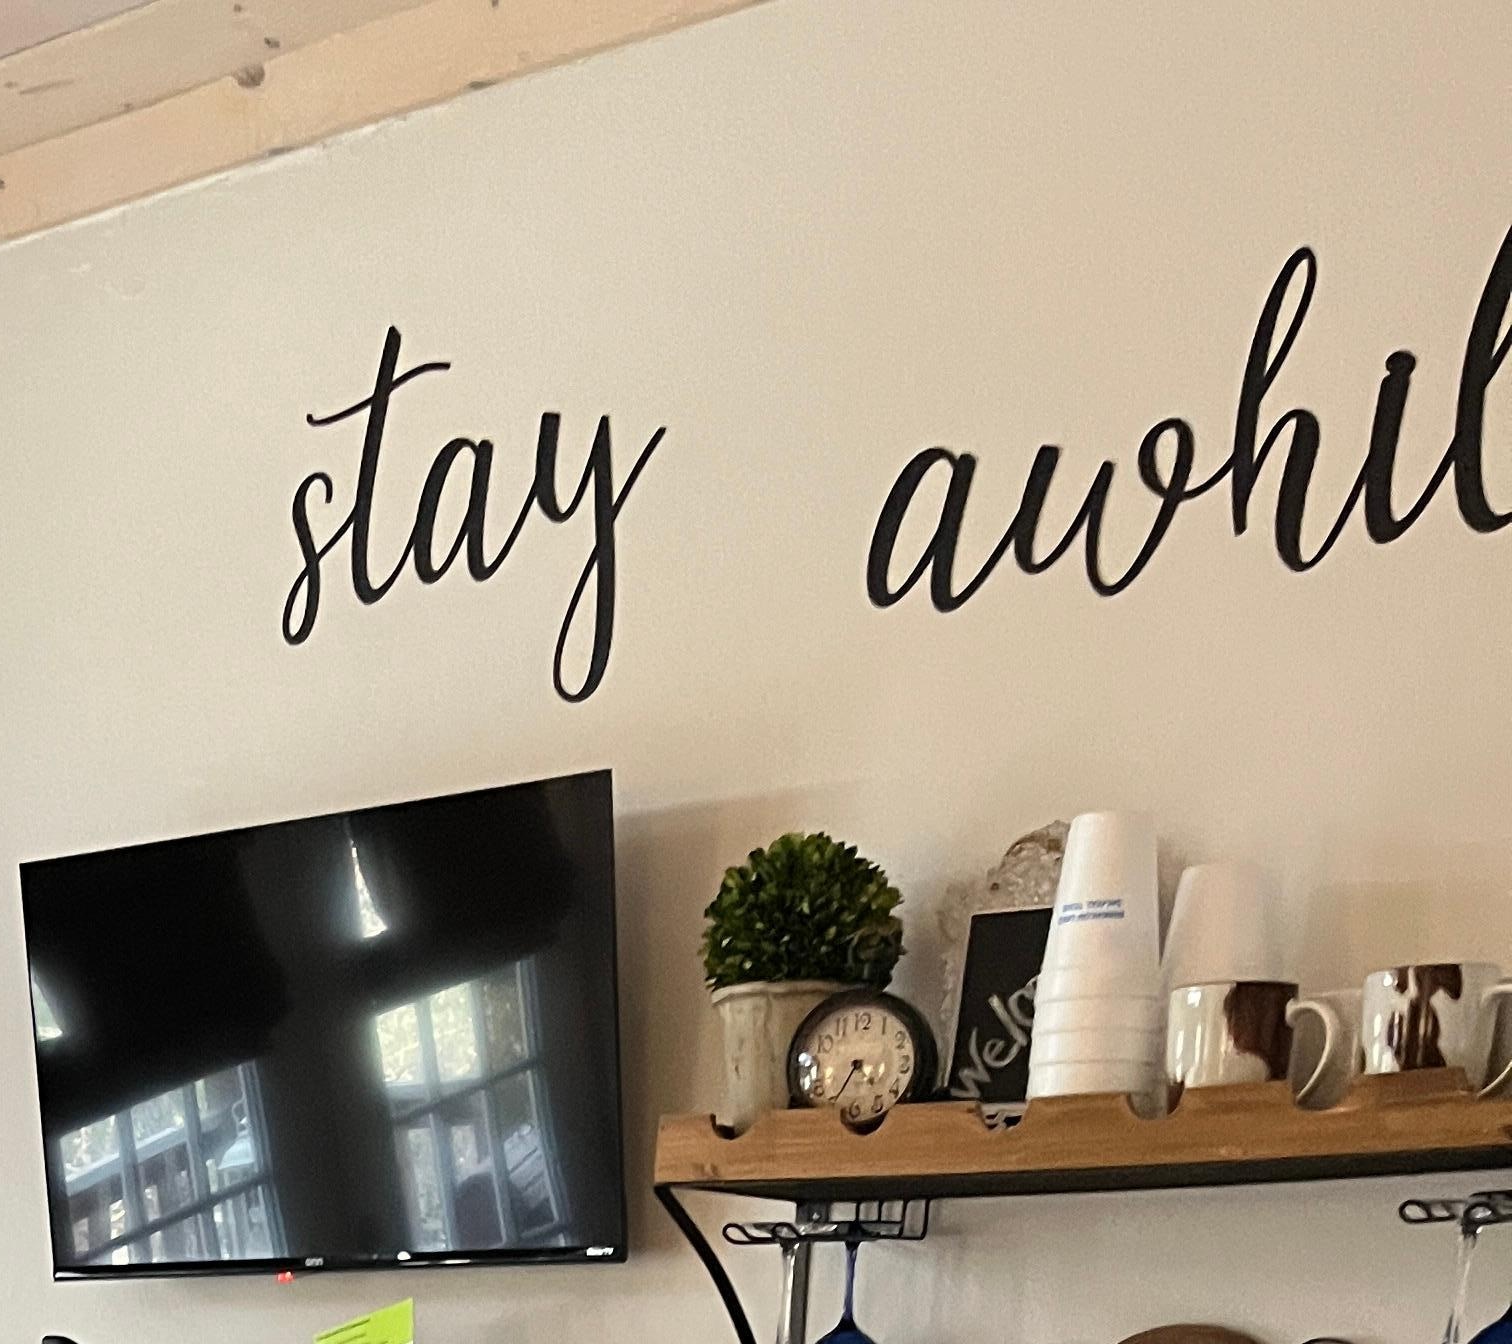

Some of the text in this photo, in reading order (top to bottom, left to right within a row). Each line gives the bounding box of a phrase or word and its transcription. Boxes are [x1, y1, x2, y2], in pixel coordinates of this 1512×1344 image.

[282, 325, 667, 703] stay
[854, 1012, 872, 1032] 12
[881, 1016, 888, 1036] 1
[817, 1033, 834, 1054] 10
[895, 1030, 907, 1049] 2
[899, 1054, 911, 1075] 3
[889, 1078, 900, 1099] 4
[871, 1094, 884, 1113] 5
